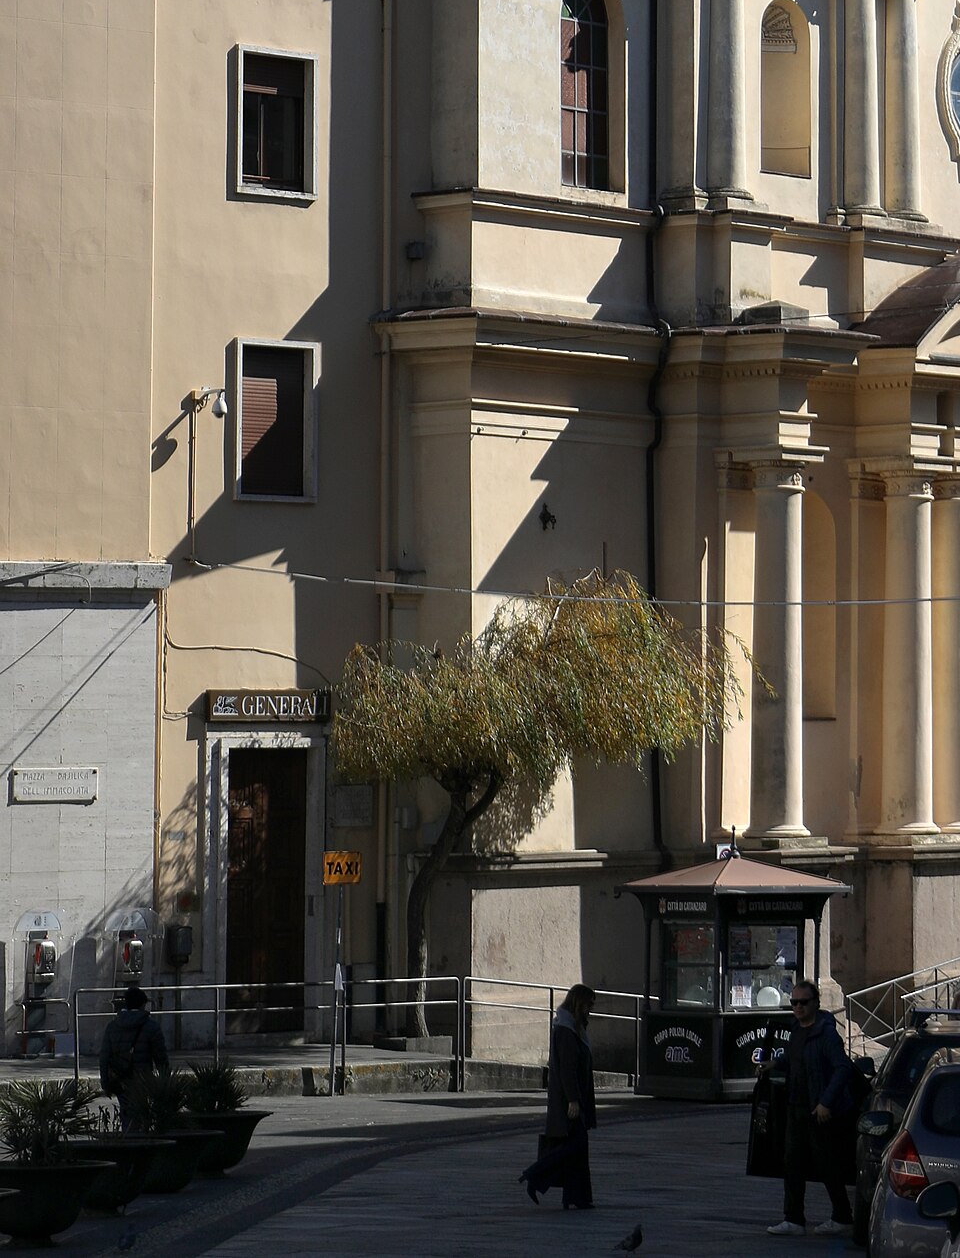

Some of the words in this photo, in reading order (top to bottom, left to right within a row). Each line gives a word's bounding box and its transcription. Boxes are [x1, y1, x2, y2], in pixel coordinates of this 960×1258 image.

[241, 695, 328, 716] GENERALI
[22, 772, 45, 781] PIAZZA
[57, 772, 89, 781] BASILICA
[326, 861, 359, 875] TAXI
[736, 1030, 755, 1048] CORPO
